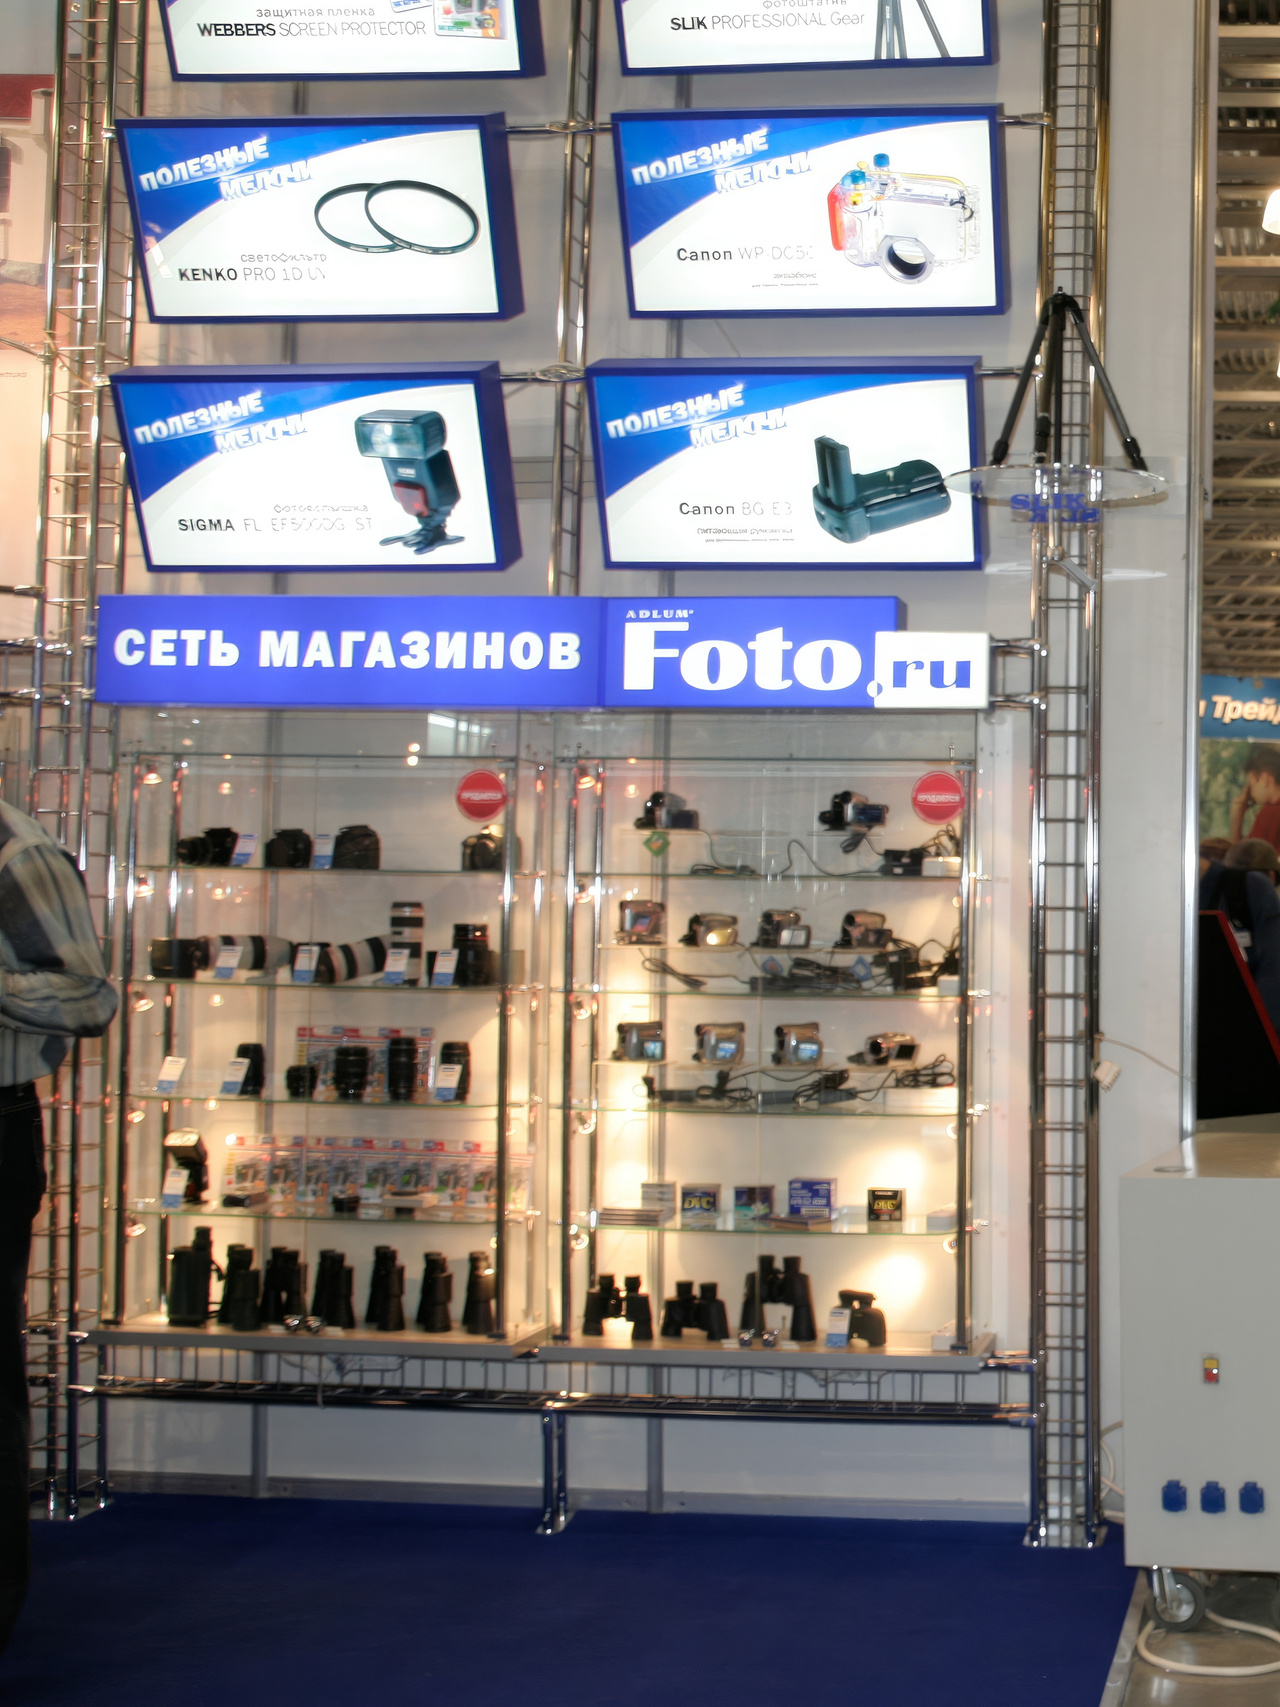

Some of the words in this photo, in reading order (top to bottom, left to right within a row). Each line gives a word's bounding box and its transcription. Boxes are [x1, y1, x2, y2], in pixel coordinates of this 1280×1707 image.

[197, 22, 276, 38] WEBBERS
[278, 21, 338, 37] SCREEN
[341, 20, 427, 37] PROTECTOR
[670, 16, 708, 31] SLIK
[711, 13, 826, 30] PROFESSIONAL
[830, 11, 865, 26] Gear
[139, 136, 270, 191] ПОЛЕЗНЫЕ
[631, 126, 770, 186] ПОЛЕЗНЫЕ
[676, 247, 733, 261] Canon
[178, 267, 238, 282] KENKO
[242, 266, 276, 281] PRO
[134, 390, 264, 445] ПОЛЕЗНЫЕ
[605, 381, 744, 440] ПОЛЕЗНЫЕ
[679, 501, 735, 516] Canon
[178, 518, 235, 531] SIGMA
[114, 629, 240, 667] СЕТЬ
[258, 630, 580, 671] МАГАЗИНОВ
